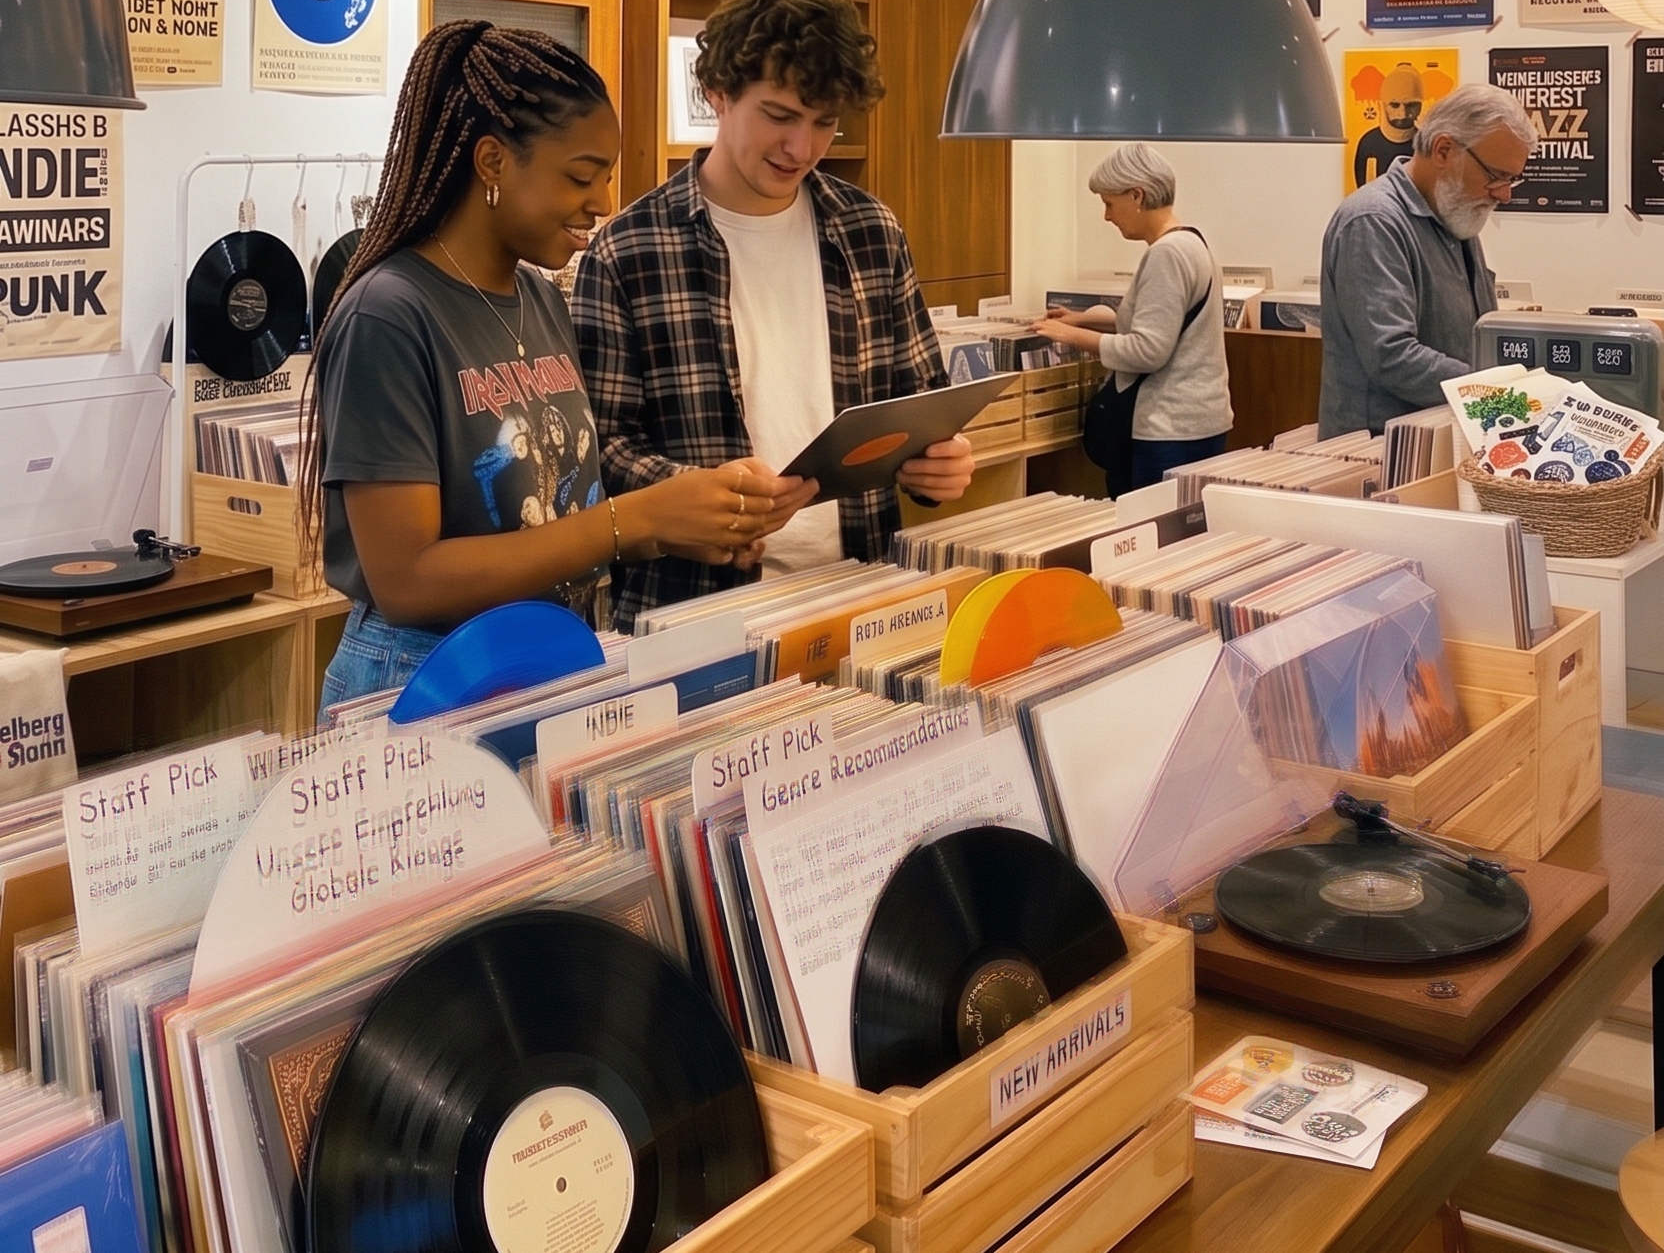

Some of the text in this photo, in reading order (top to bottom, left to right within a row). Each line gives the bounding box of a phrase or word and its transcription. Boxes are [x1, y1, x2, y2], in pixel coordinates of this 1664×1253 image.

[156, 18, 168, 35] &
[93, 114, 107, 138] B
[1113, 536, 1137, 557] INDIE
[711, 720, 823, 788] Staff Pick
[79, 773, 150, 824] Staff
[168, 756, 218, 796] Pick
[291, 755, 366, 815] Staff
[999, 1059, 1046, 1105] NEW
[1046, 1001, 1125, 1079] ARRIVALS
